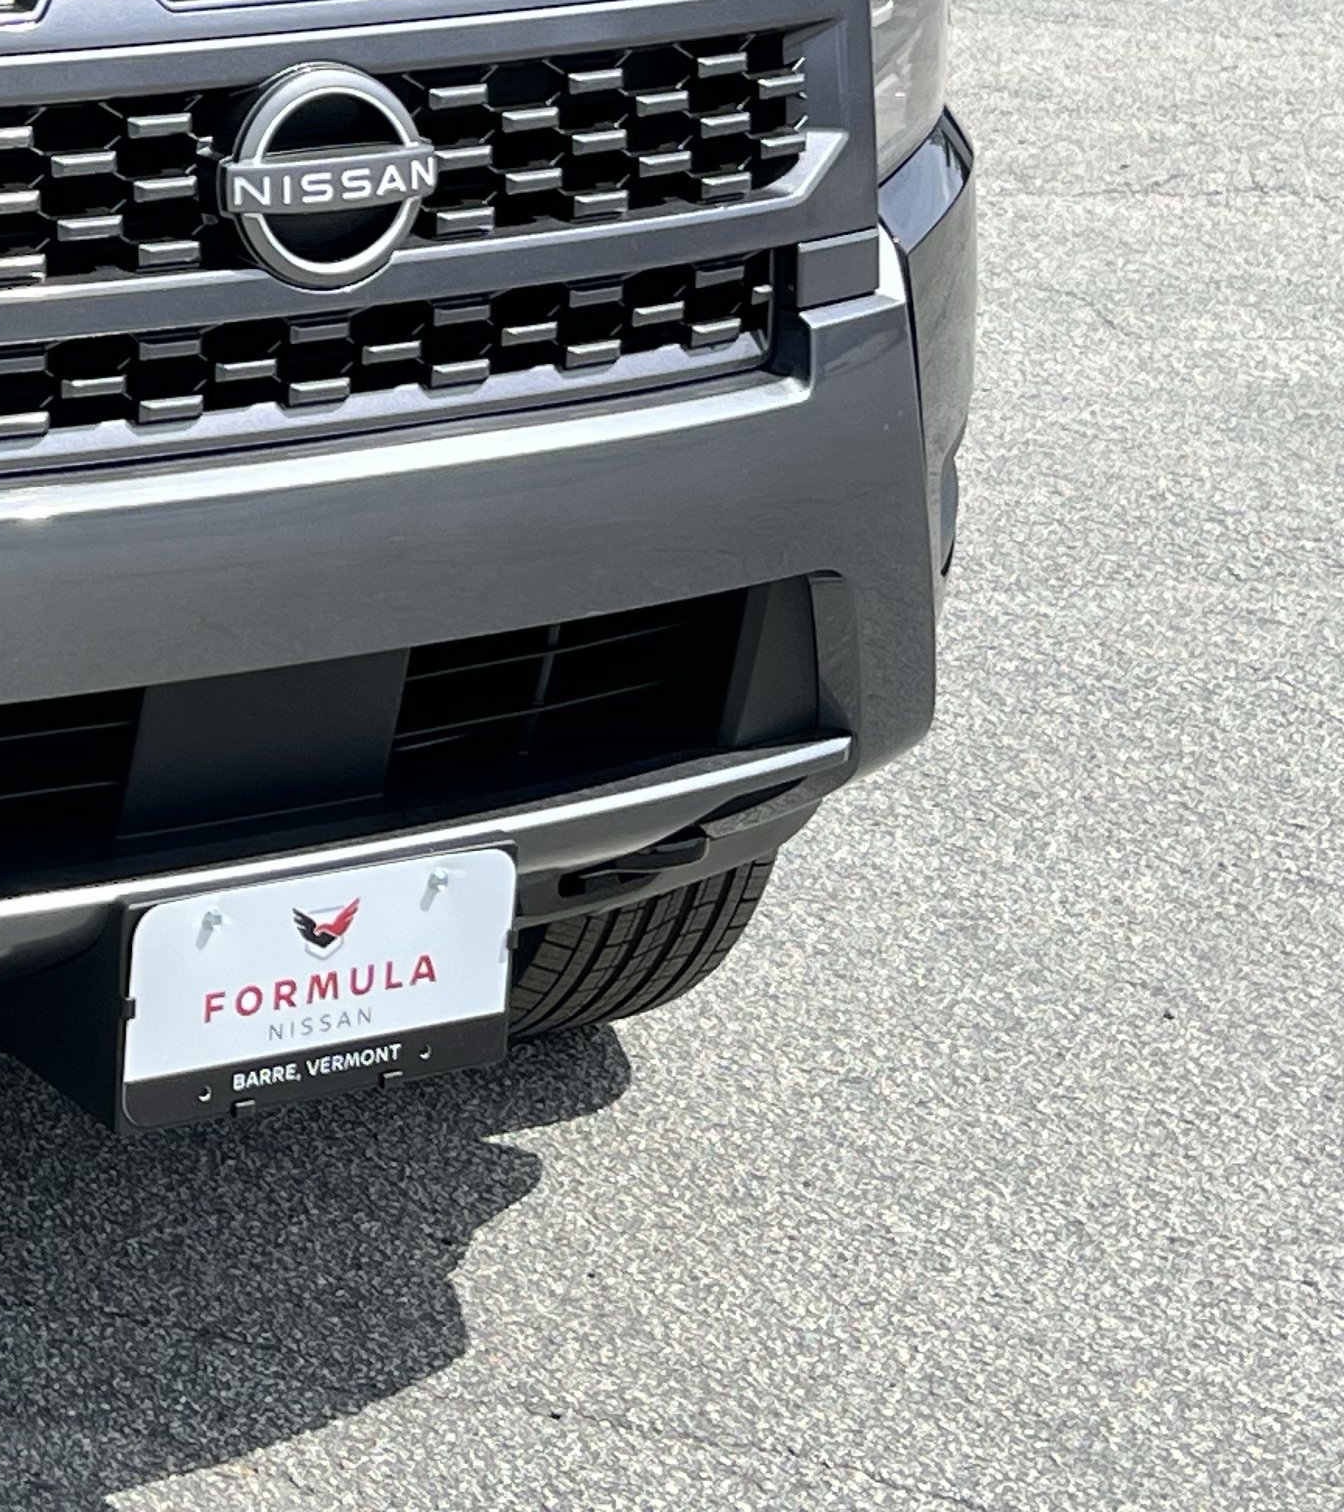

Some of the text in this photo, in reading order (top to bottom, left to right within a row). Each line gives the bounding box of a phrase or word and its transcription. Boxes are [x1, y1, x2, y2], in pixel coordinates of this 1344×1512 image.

[232, 156, 436, 207] NISSAN
[202, 954, 437, 1024] FORMULA
[268, 1007, 372, 1041] NISSAN
[232, 1043, 403, 1091] BARRE, VERMONT
